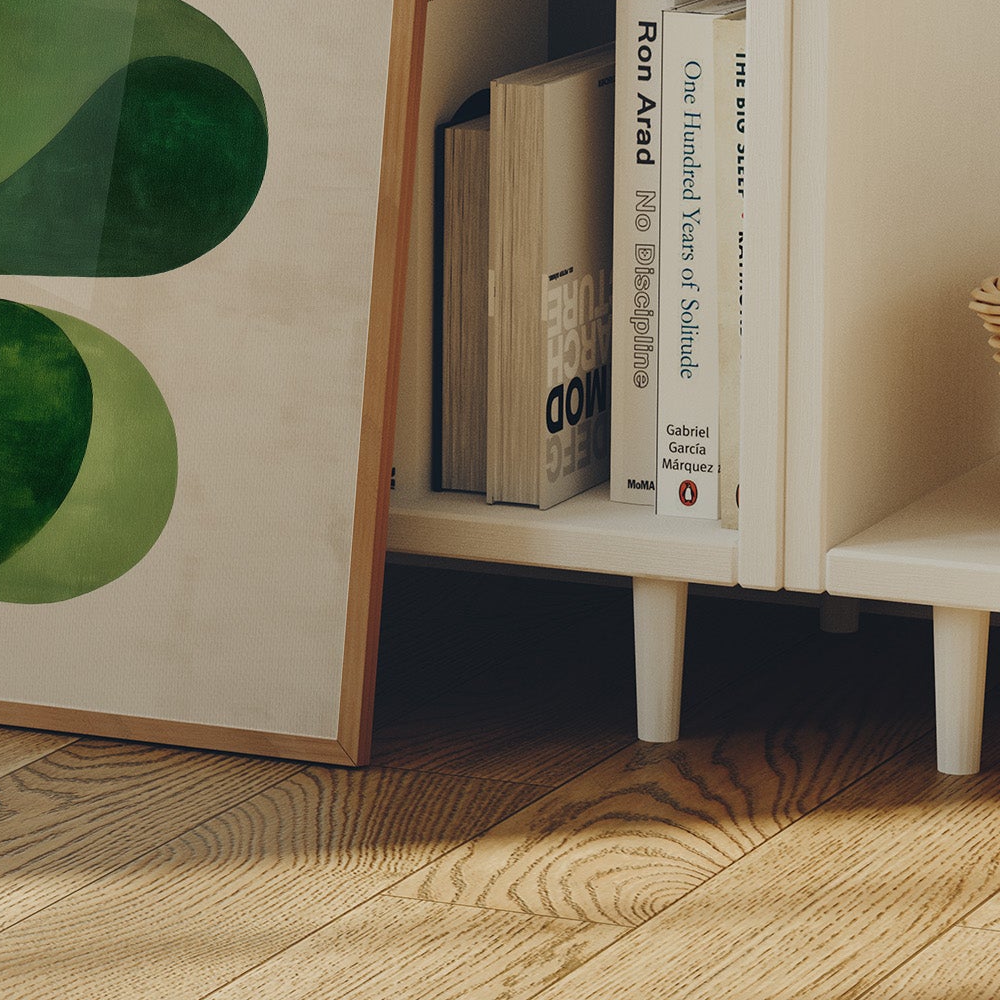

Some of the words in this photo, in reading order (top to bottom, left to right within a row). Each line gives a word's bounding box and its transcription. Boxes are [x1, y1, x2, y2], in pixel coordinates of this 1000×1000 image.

[637, 21, 657, 82] Ron
[683, 60, 702, 105] One
[636, 92, 657, 165] Arad
[682, 112, 702, 201] Hundred
[634, 190, 656, 232] No
[681, 207, 701, 261] Years
[680, 268, 700, 292] of
[629, 243, 655, 389] Discipline
[680, 298, 700, 380] Solitude
[545, 366, 607, 434] MOD
[666, 424, 710, 439] Gabriel
[668, 441, 707, 456] García
[627, 479, 655, 491] MoMA
[661, 457, 714, 474] Márquez
